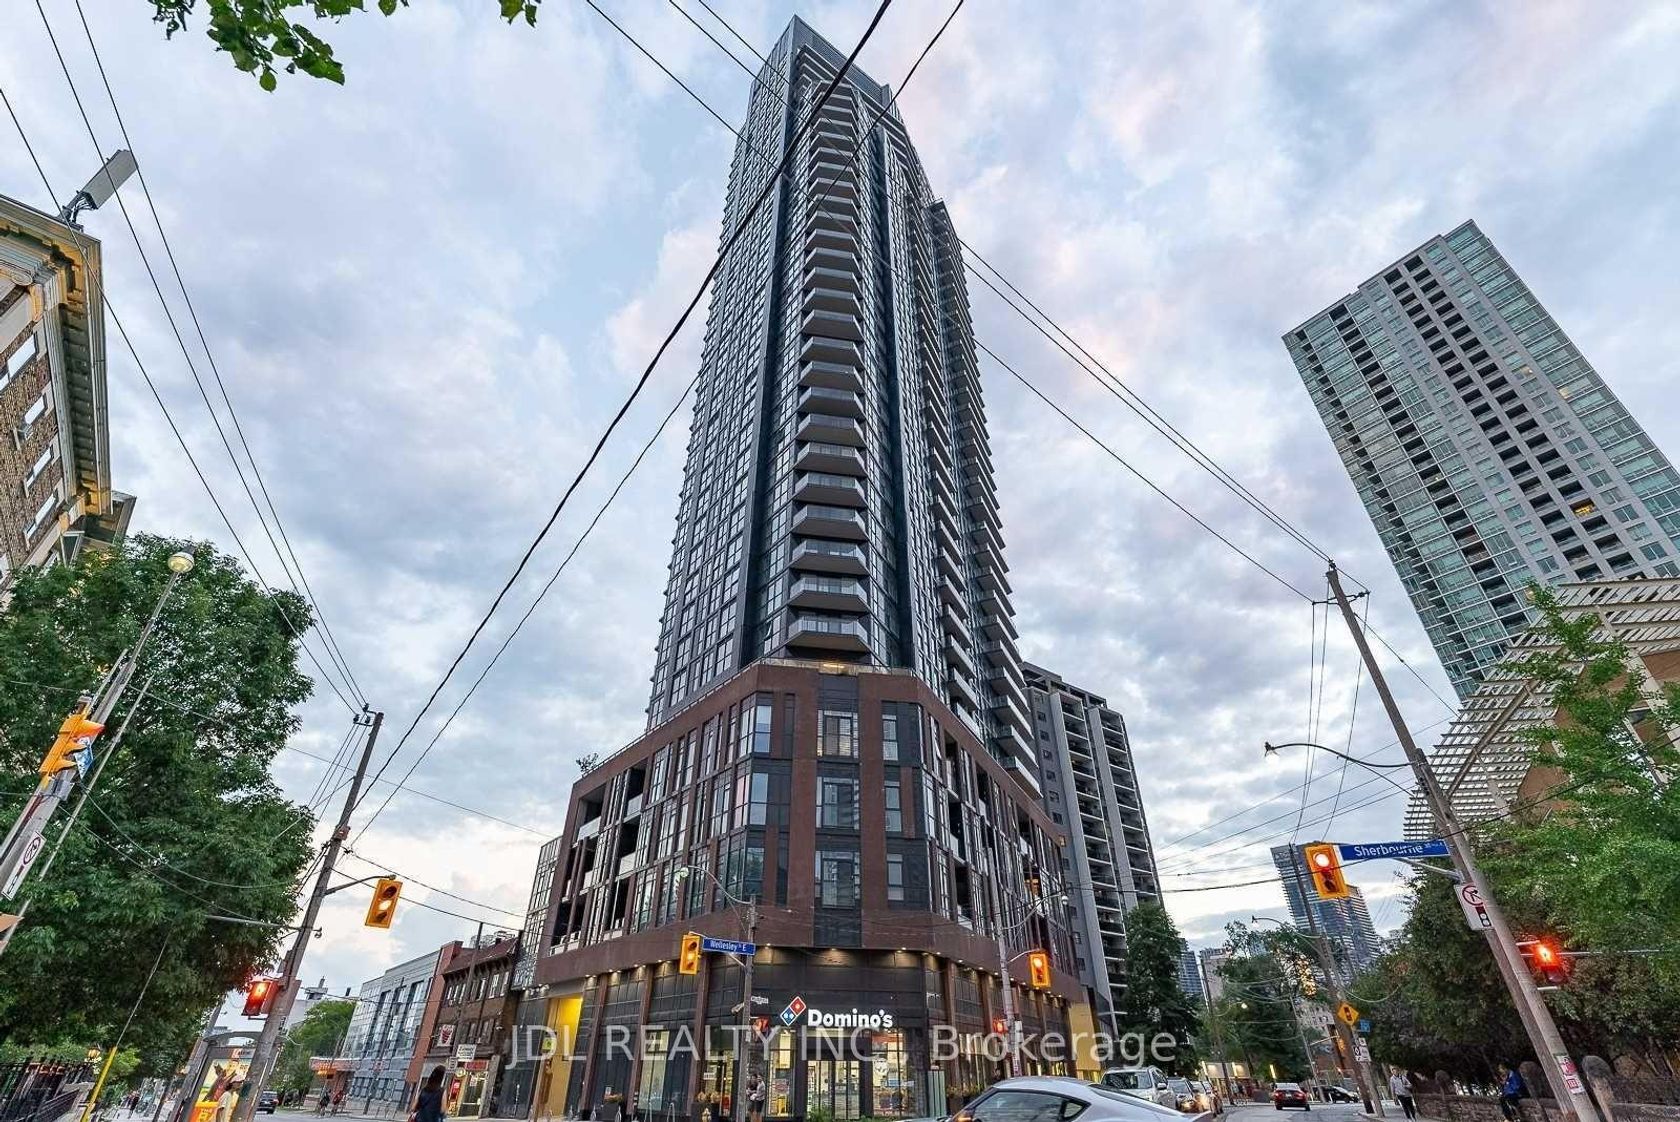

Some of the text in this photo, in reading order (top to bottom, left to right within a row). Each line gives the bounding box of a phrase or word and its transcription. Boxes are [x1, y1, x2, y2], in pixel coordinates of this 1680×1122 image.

[1354, 844, 1423, 857] Sherbourne
[711, 940, 737, 952] Wellesley
[807, 1008, 893, 1028] Domino's
